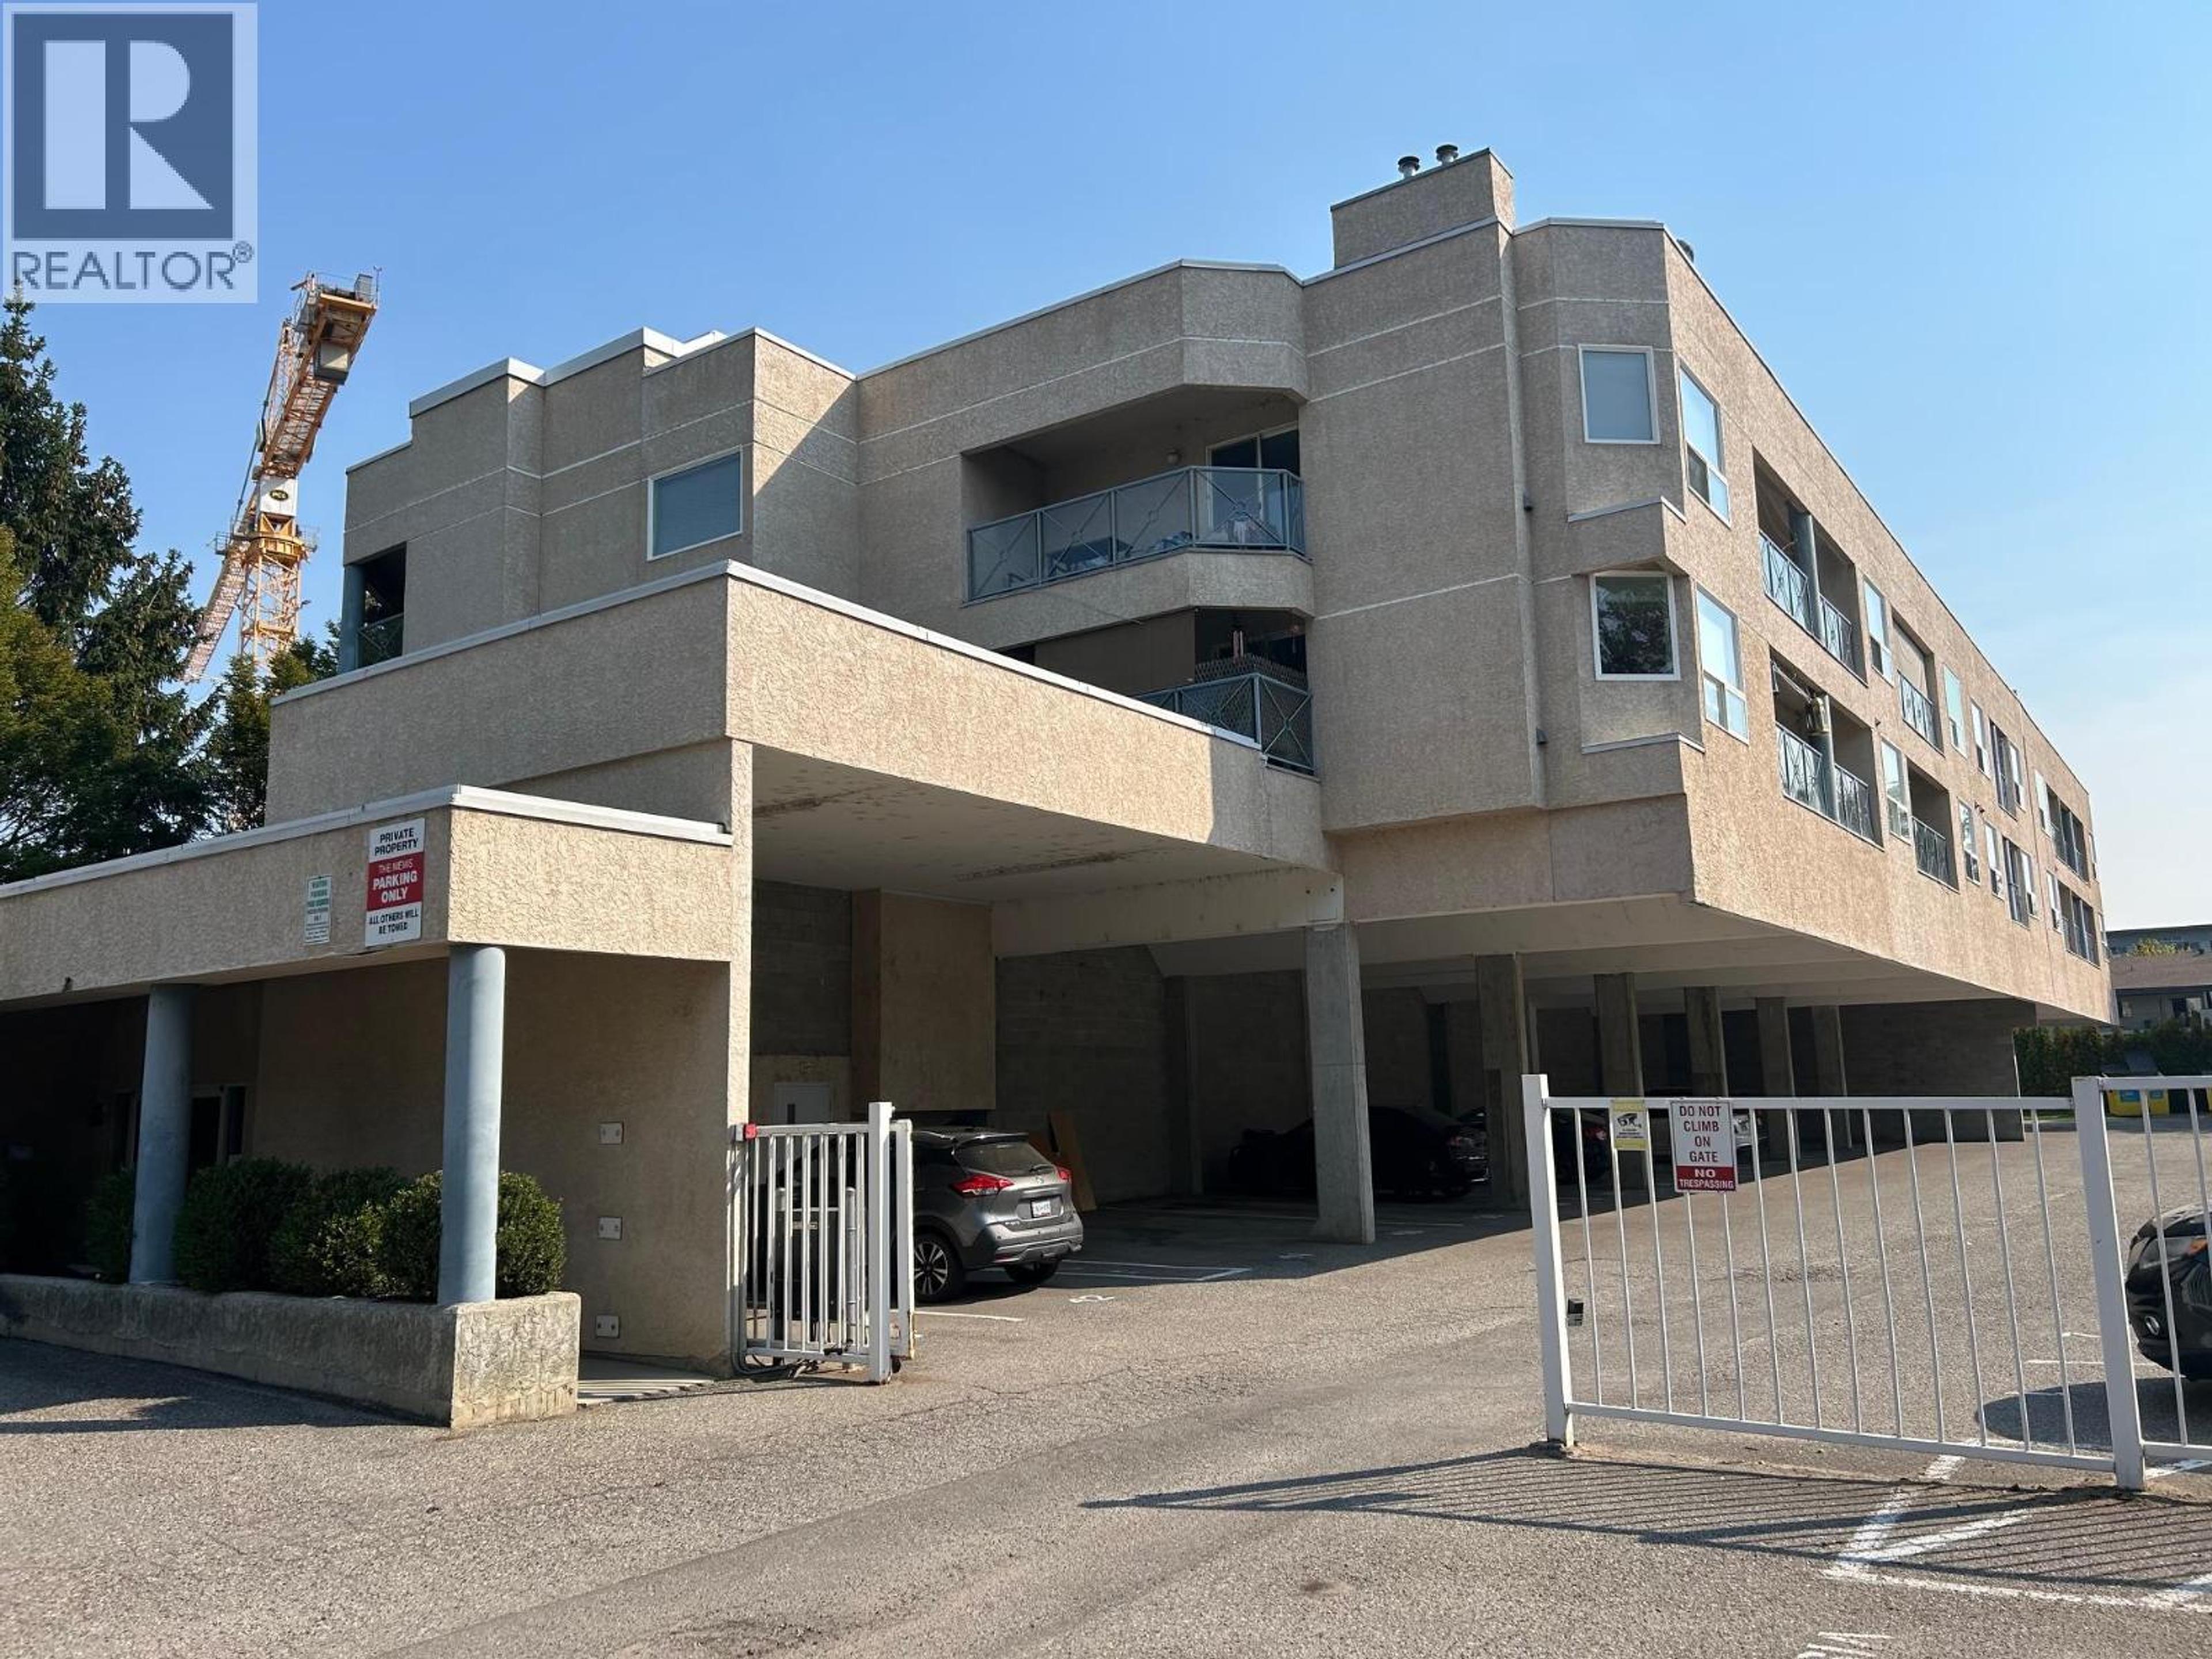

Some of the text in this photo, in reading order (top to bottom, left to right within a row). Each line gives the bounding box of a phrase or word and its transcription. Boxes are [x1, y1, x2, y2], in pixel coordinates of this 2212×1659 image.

[380, 827, 414, 843] PRIVATE
[374, 838, 419, 856] PROPERTY
[373, 870, 418, 891] PARKING
[381, 886, 408, 903] ONLY
[369, 907, 419, 925] ALL OTHERS WILL
[379, 922, 408, 934] BE TOWED
[1680, 1105, 1722, 1117] DO NOT
[1683, 1120, 1719, 1132] CLIMB
[1695, 1136, 1711, 1147] ON
[1689, 1151, 1719, 1162] GATE
[1694, 1168, 1716, 1178] NO
[1679, 1179, 1734, 1190] TRESPASSING
